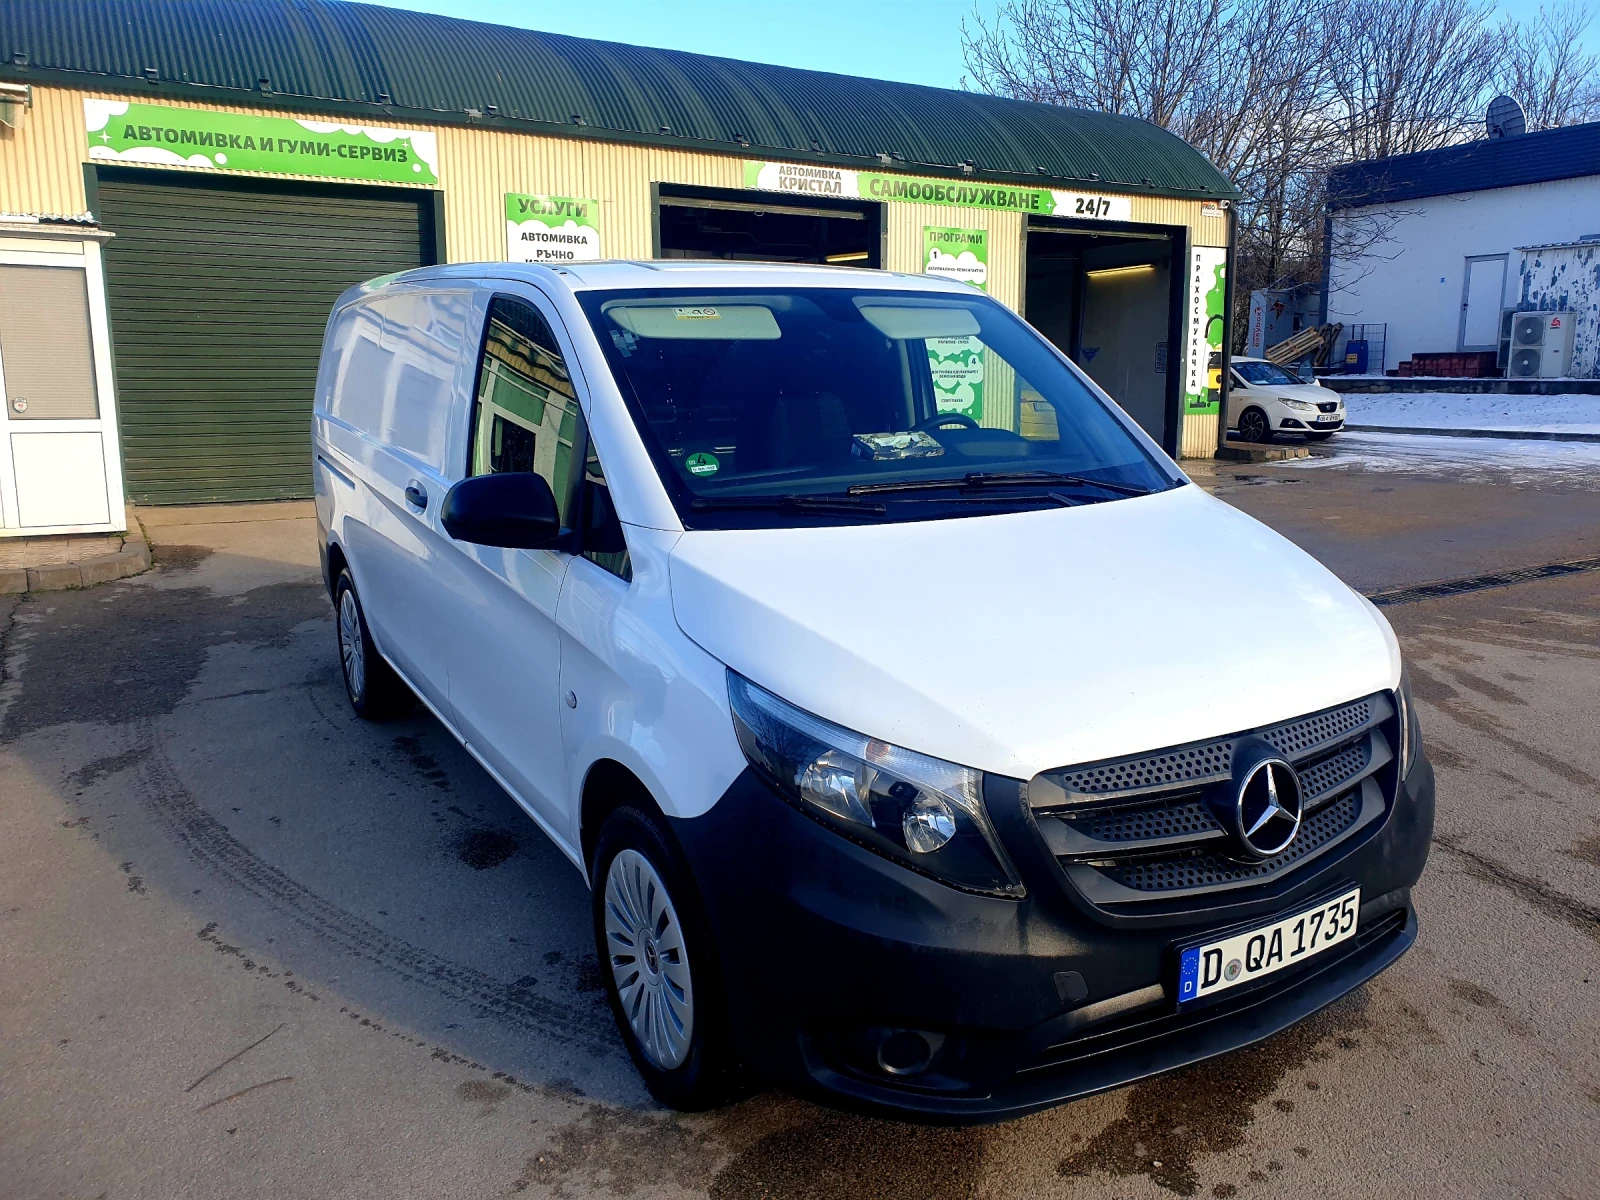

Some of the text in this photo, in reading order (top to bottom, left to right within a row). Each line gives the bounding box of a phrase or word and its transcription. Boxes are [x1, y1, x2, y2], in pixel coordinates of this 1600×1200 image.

[123, 124, 408, 163] АВТОМИВКА И ГУМИ-СЕРВИЗ
[779, 165, 842, 180] АВТОМИВКА
[779, 176, 842, 194] КРИСТАЛ
[869, 178, 1040, 210] САМООБСЛУЖВАНЕ
[517, 198, 588, 218] УСЛУГИ
[1075, 197, 1111, 218] 24/7
[520, 232, 588, 245] АВТОМИВКА
[929, 231, 983, 244] ПРОГРАМИ
[536, 249, 574, 260] РЪЧНО
[933, 251, 937, 259] 1
[1190, 254, 1201, 387] ПРАХОСМУКАЧКА
[697, 454, 707, 465] 4
[1201, 895, 1356, 989] D QA 1735
[1183, 980, 1193, 994] D
